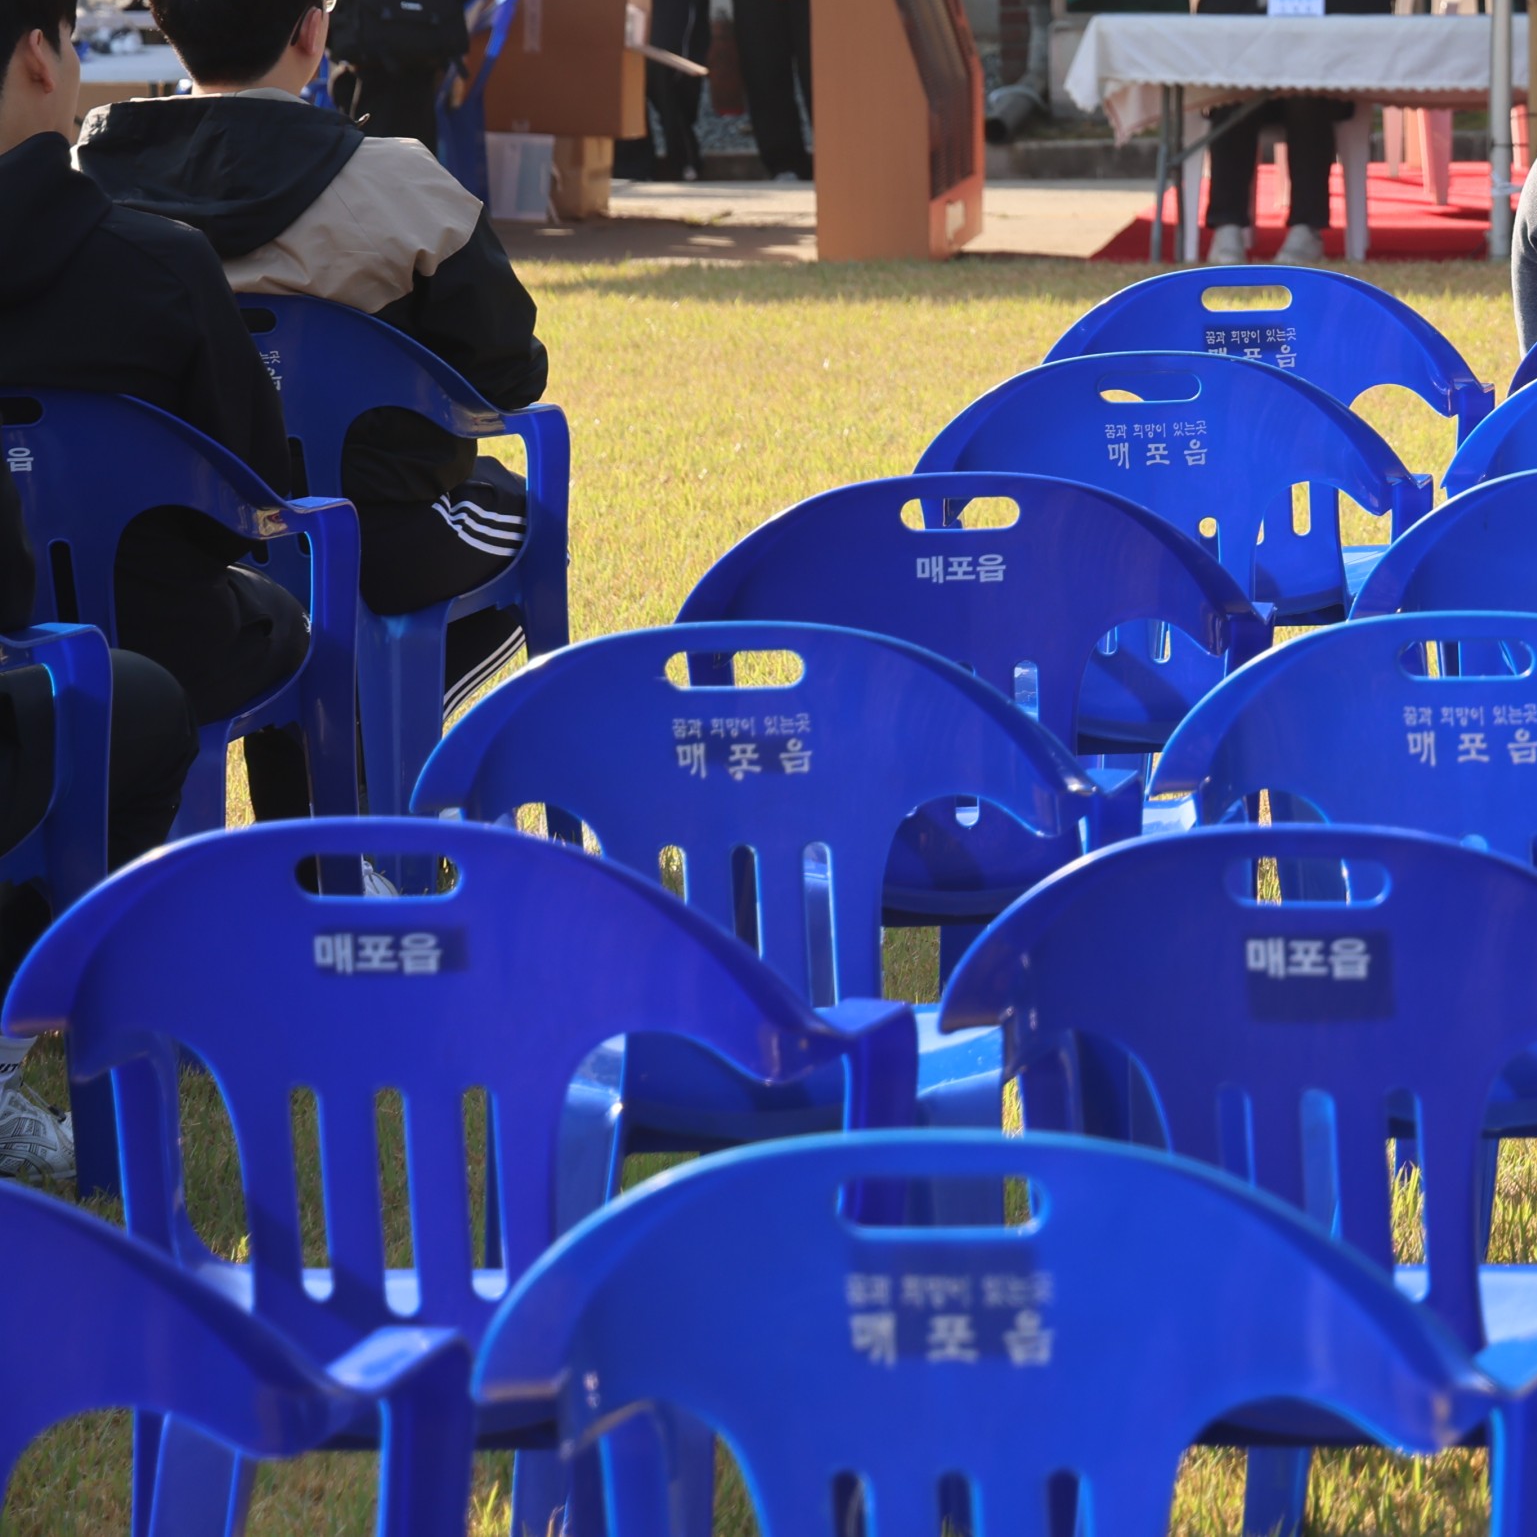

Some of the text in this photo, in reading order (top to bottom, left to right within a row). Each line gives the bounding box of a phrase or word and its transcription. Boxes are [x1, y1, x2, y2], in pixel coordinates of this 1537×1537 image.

[1206, 330, 1225, 344] 꿈과
[1231, 329, 1260, 344] 희망이
[1105, 424, 1127, 439] 꿈과
[1133, 423, 1166, 439] 희망이
[916, 554, 1007, 583] 매포읍
[314, 932, 442, 975] 매포읍
[1246, 936, 1371, 979] 매포읍
